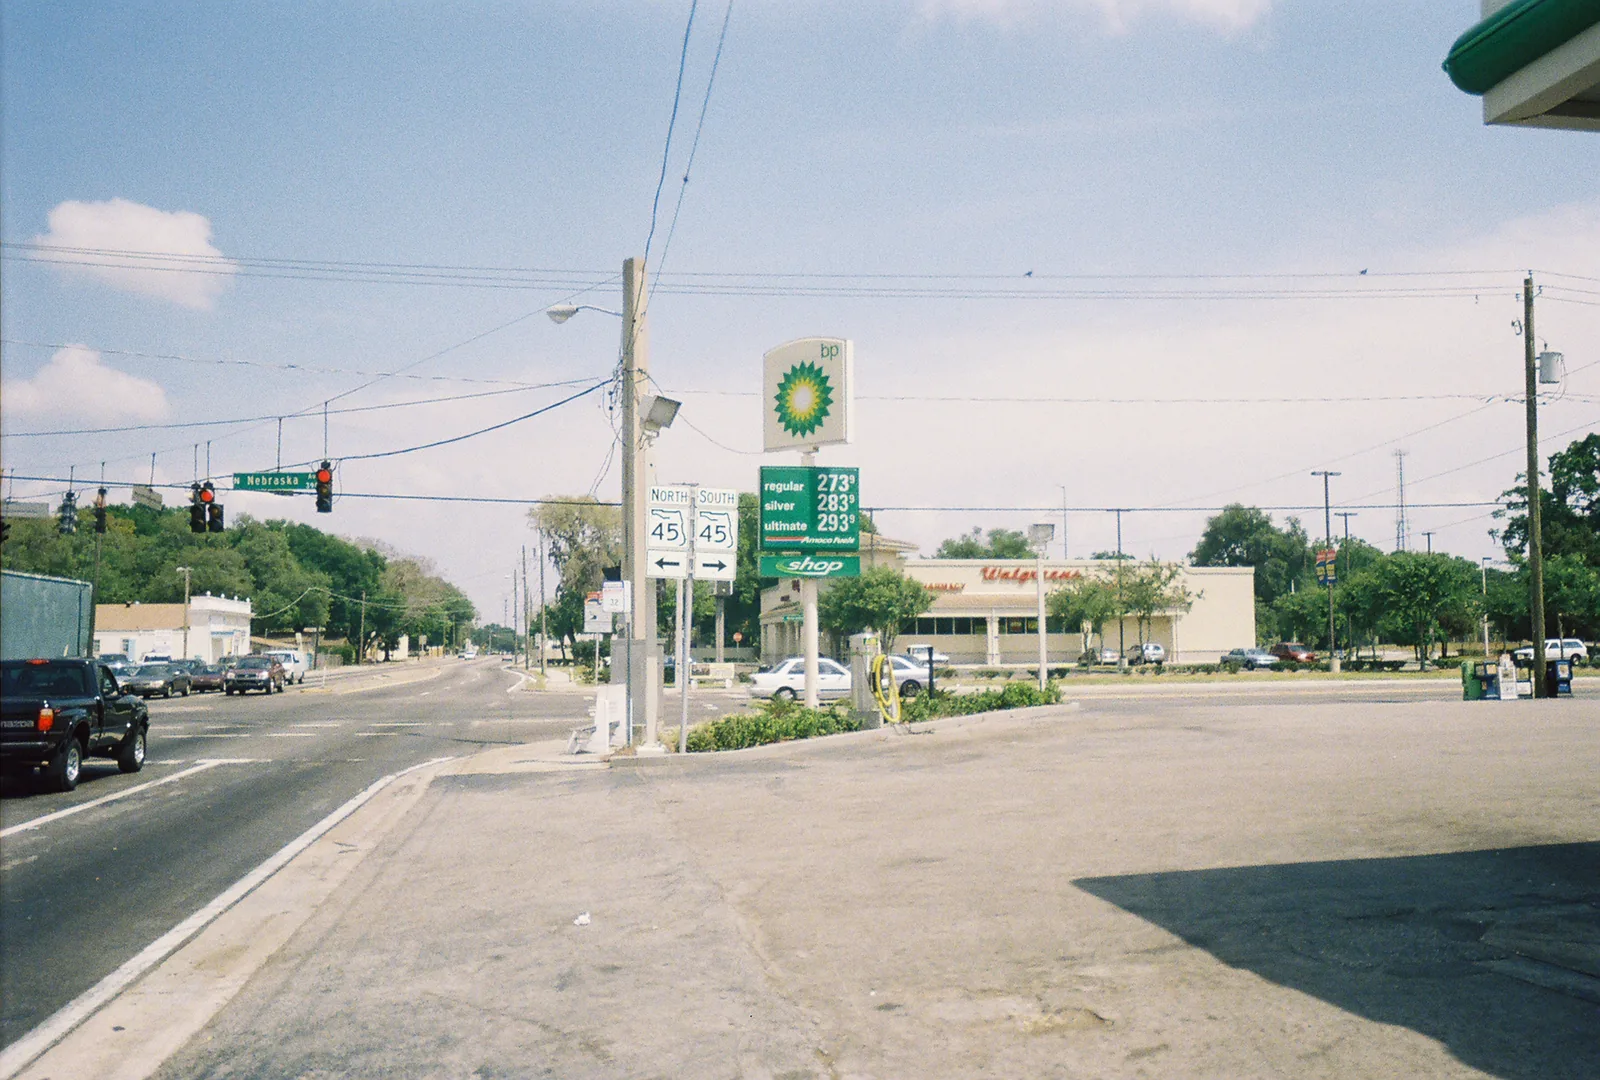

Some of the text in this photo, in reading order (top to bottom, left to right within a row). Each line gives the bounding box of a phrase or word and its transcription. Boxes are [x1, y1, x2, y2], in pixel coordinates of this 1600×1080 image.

[820, 343, 839, 361] bp
[232, 477, 240, 485] N
[247, 475, 299, 486] Nebraska
[764, 481, 805, 494] regular
[651, 488, 688, 503] NORTH
[699, 490, 735, 505] SOUTH
[764, 500, 796, 511] silver
[651, 522, 679, 541] 45
[699, 524, 727, 543] 45
[764, 520, 808, 532] ultimate
[801, 536, 833, 544] Amoco
[788, 556, 844, 573] shop
